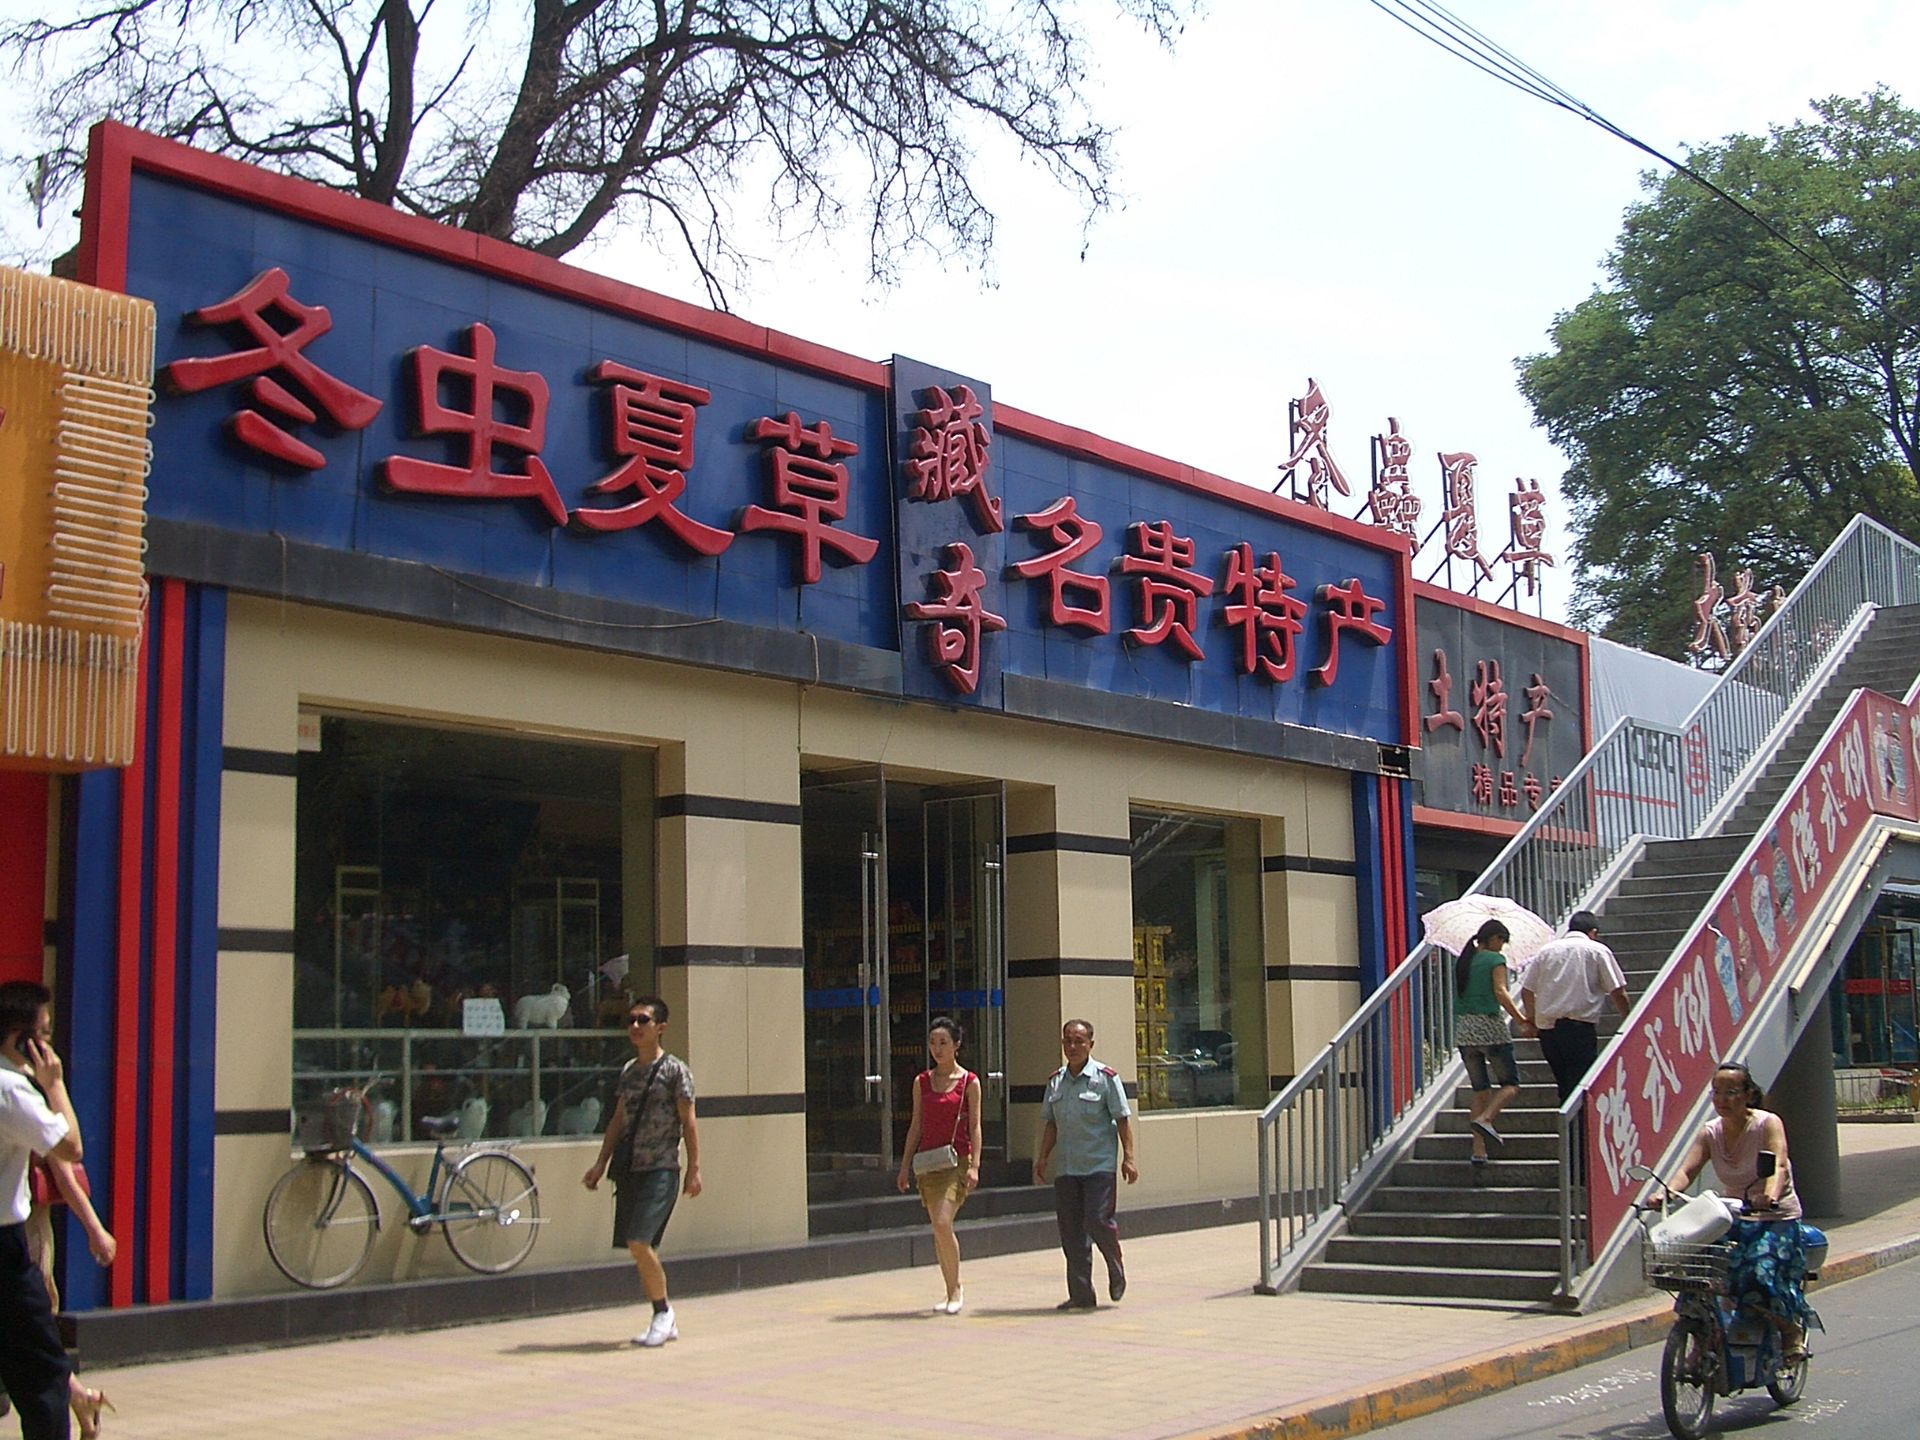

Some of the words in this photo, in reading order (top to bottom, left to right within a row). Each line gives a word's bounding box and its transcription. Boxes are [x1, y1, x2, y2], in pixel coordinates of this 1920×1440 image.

[168, 267, 880, 585] 冬虫夏草
[906, 384, 1008, 695] 藏奇
[1010, 495, 1393, 687] 名贵特产
[1425, 648, 1554, 768] 土特产
